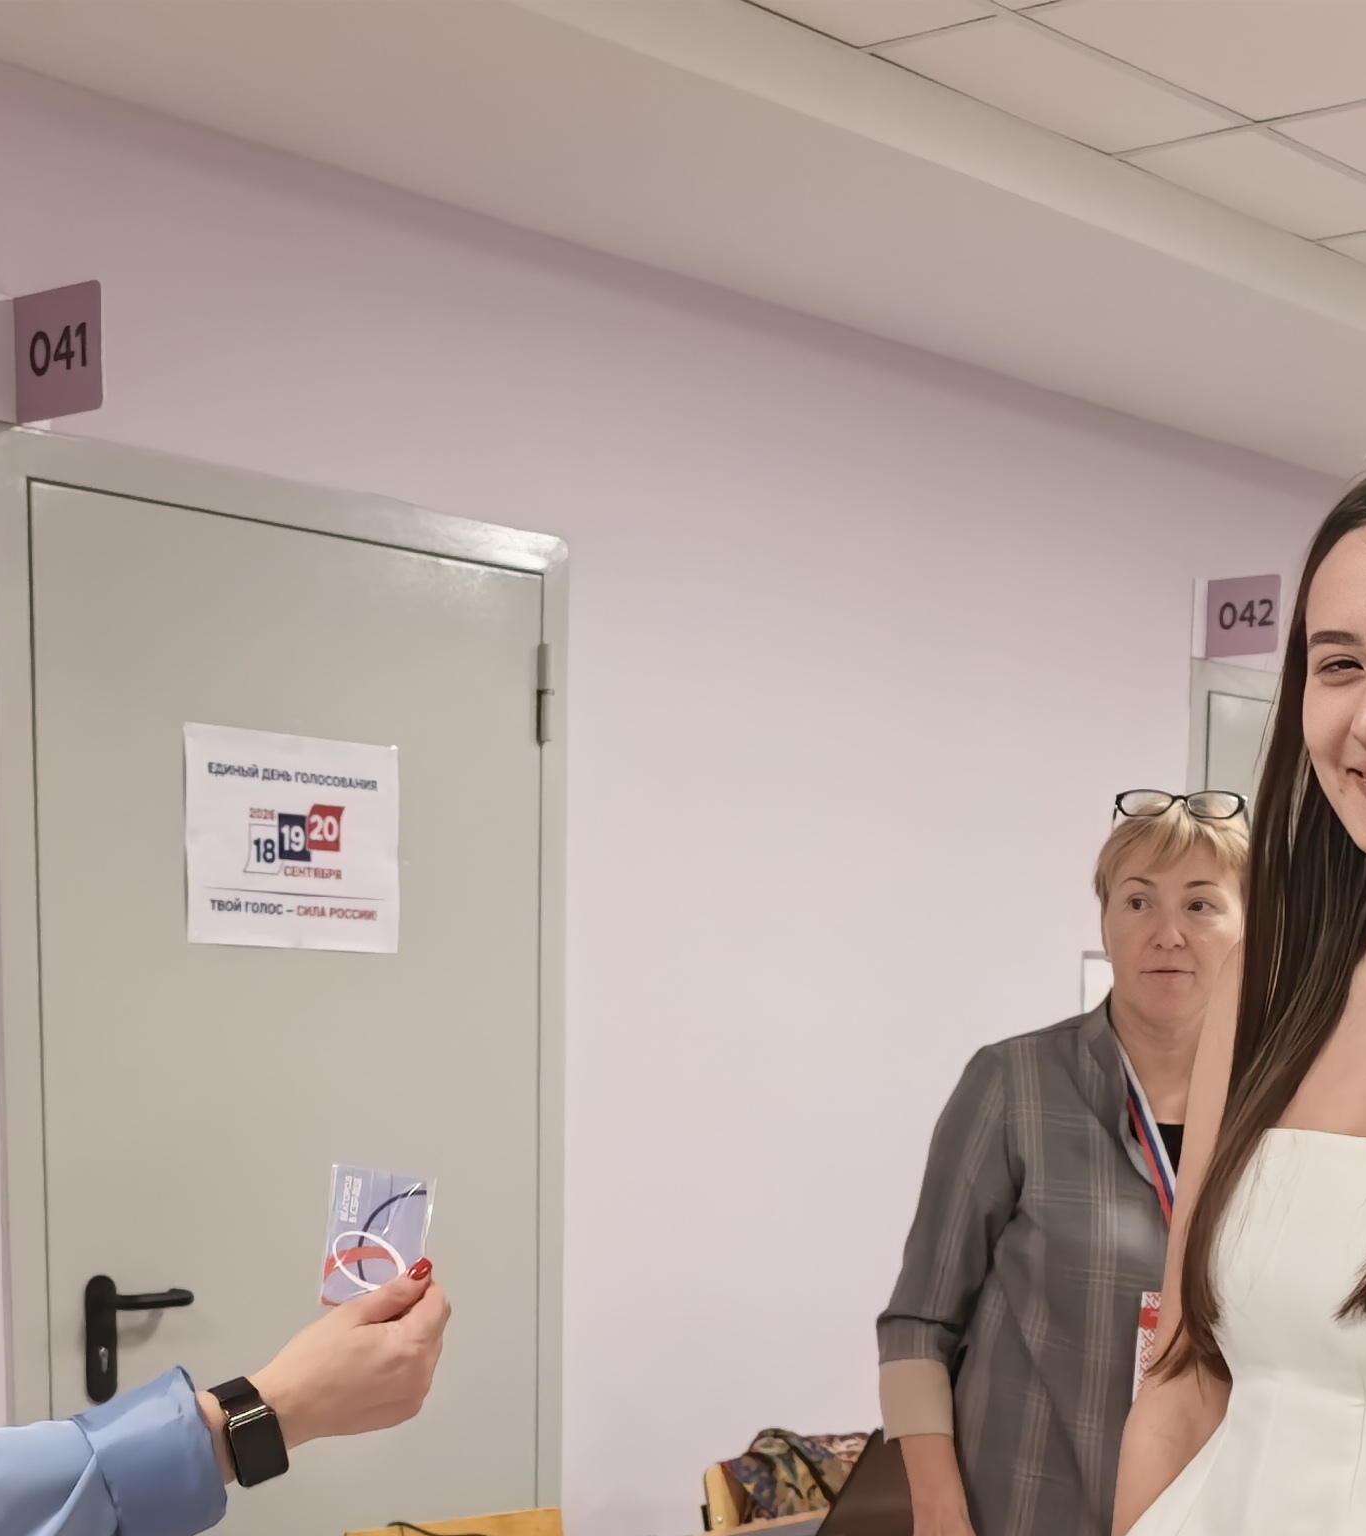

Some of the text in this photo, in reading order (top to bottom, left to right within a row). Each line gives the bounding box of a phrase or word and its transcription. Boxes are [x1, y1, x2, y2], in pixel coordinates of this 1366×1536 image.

[30, 322, 88, 377] 041
[1219, 598, 1276, 630] 042
[208, 762, 378, 791] ЕДИНЫЙ ДЕНЬ ГОЛОСОВАНИЯ
[254, 814, 339, 863] 18 19 20
[210, 898, 242, 912] ТВОЙ
[245, 902, 283, 915] ГОЛОС
[296, 905, 326, 917] СИЛА
